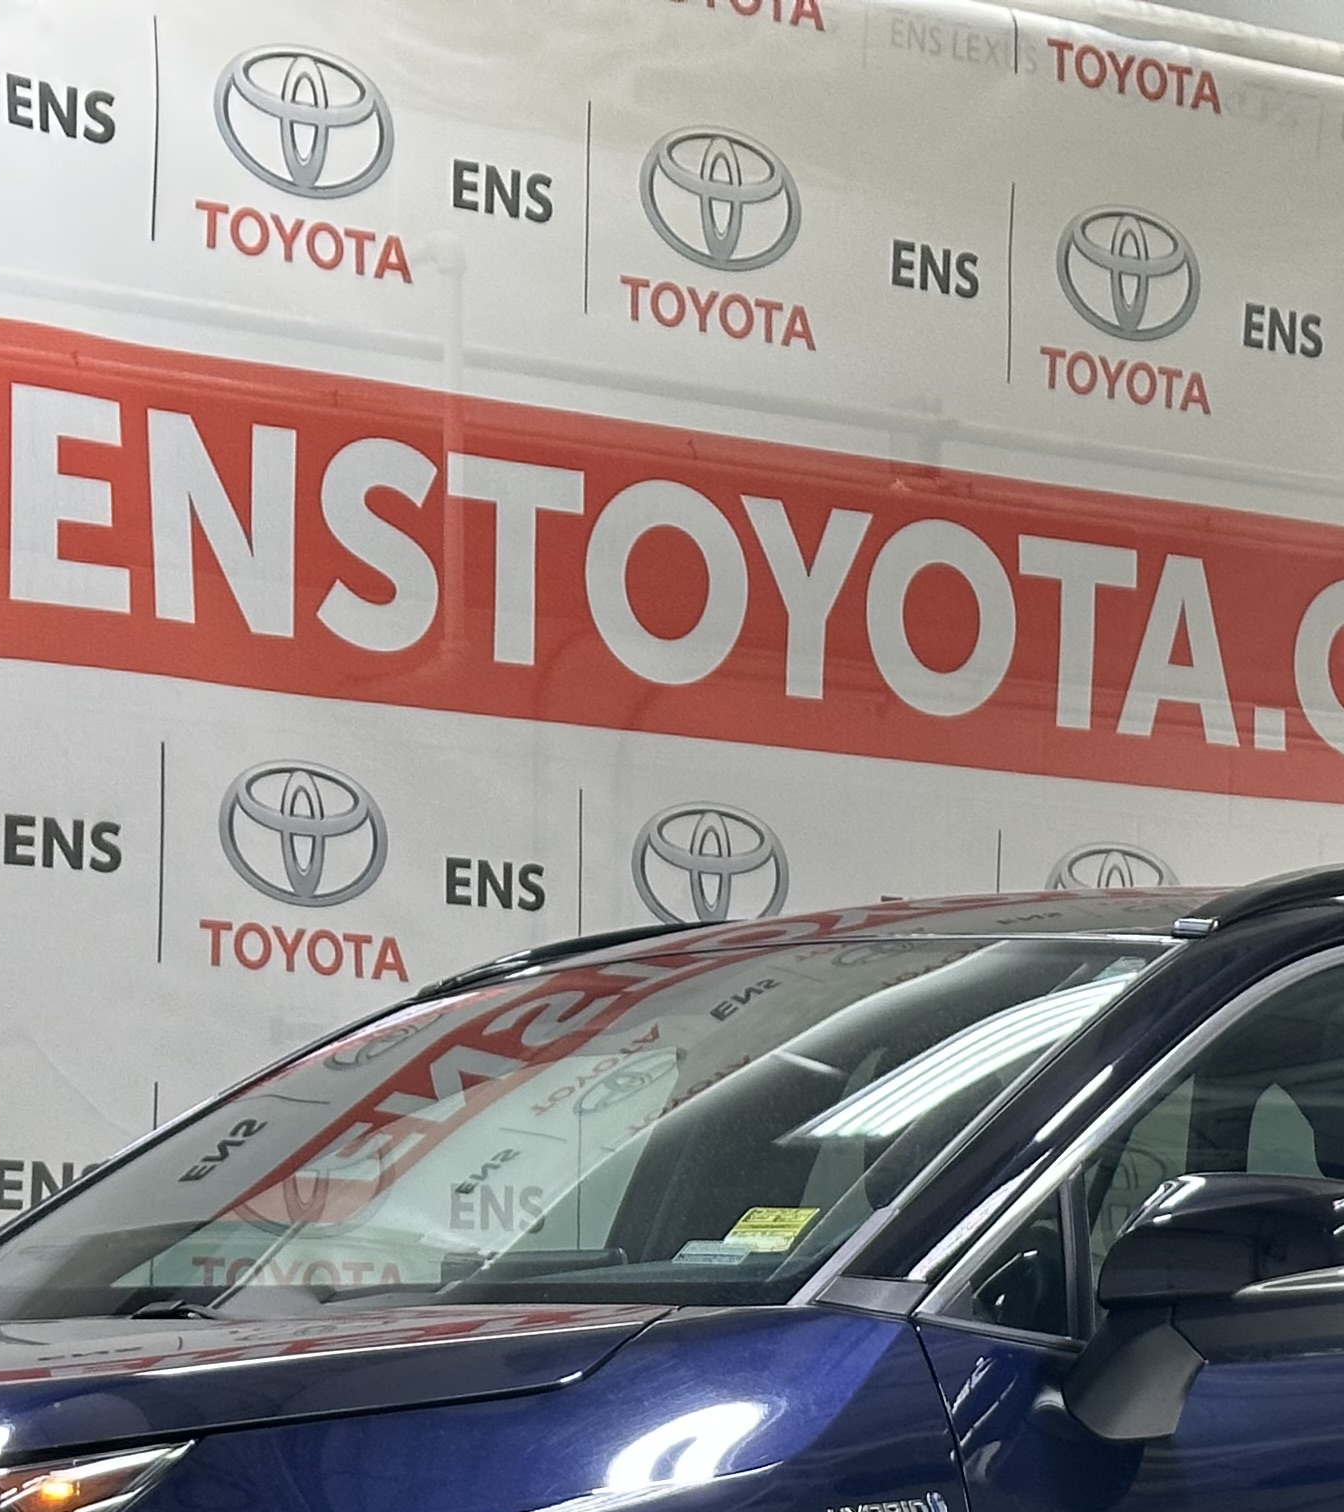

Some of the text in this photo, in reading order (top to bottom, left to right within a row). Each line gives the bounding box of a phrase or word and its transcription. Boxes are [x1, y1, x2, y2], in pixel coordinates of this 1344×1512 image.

[6, 72, 116, 144] ENS
[1047, 39, 1221, 115] TOYOTA
[453, 159, 553, 224] ENS
[195, 199, 413, 285] TOYOTA
[891, 239, 980, 300] ENS
[620, 274, 817, 352] TOYOTA
[1243, 302, 1323, 359] ENS
[1040, 347, 1211, 415] TOYOTA
[3, 813, 123, 874] ENS
[444, 857, 546, 911] ENS
[199, 919, 409, 983] TOYOTA
[450, 1183, 545, 1235] ENS
